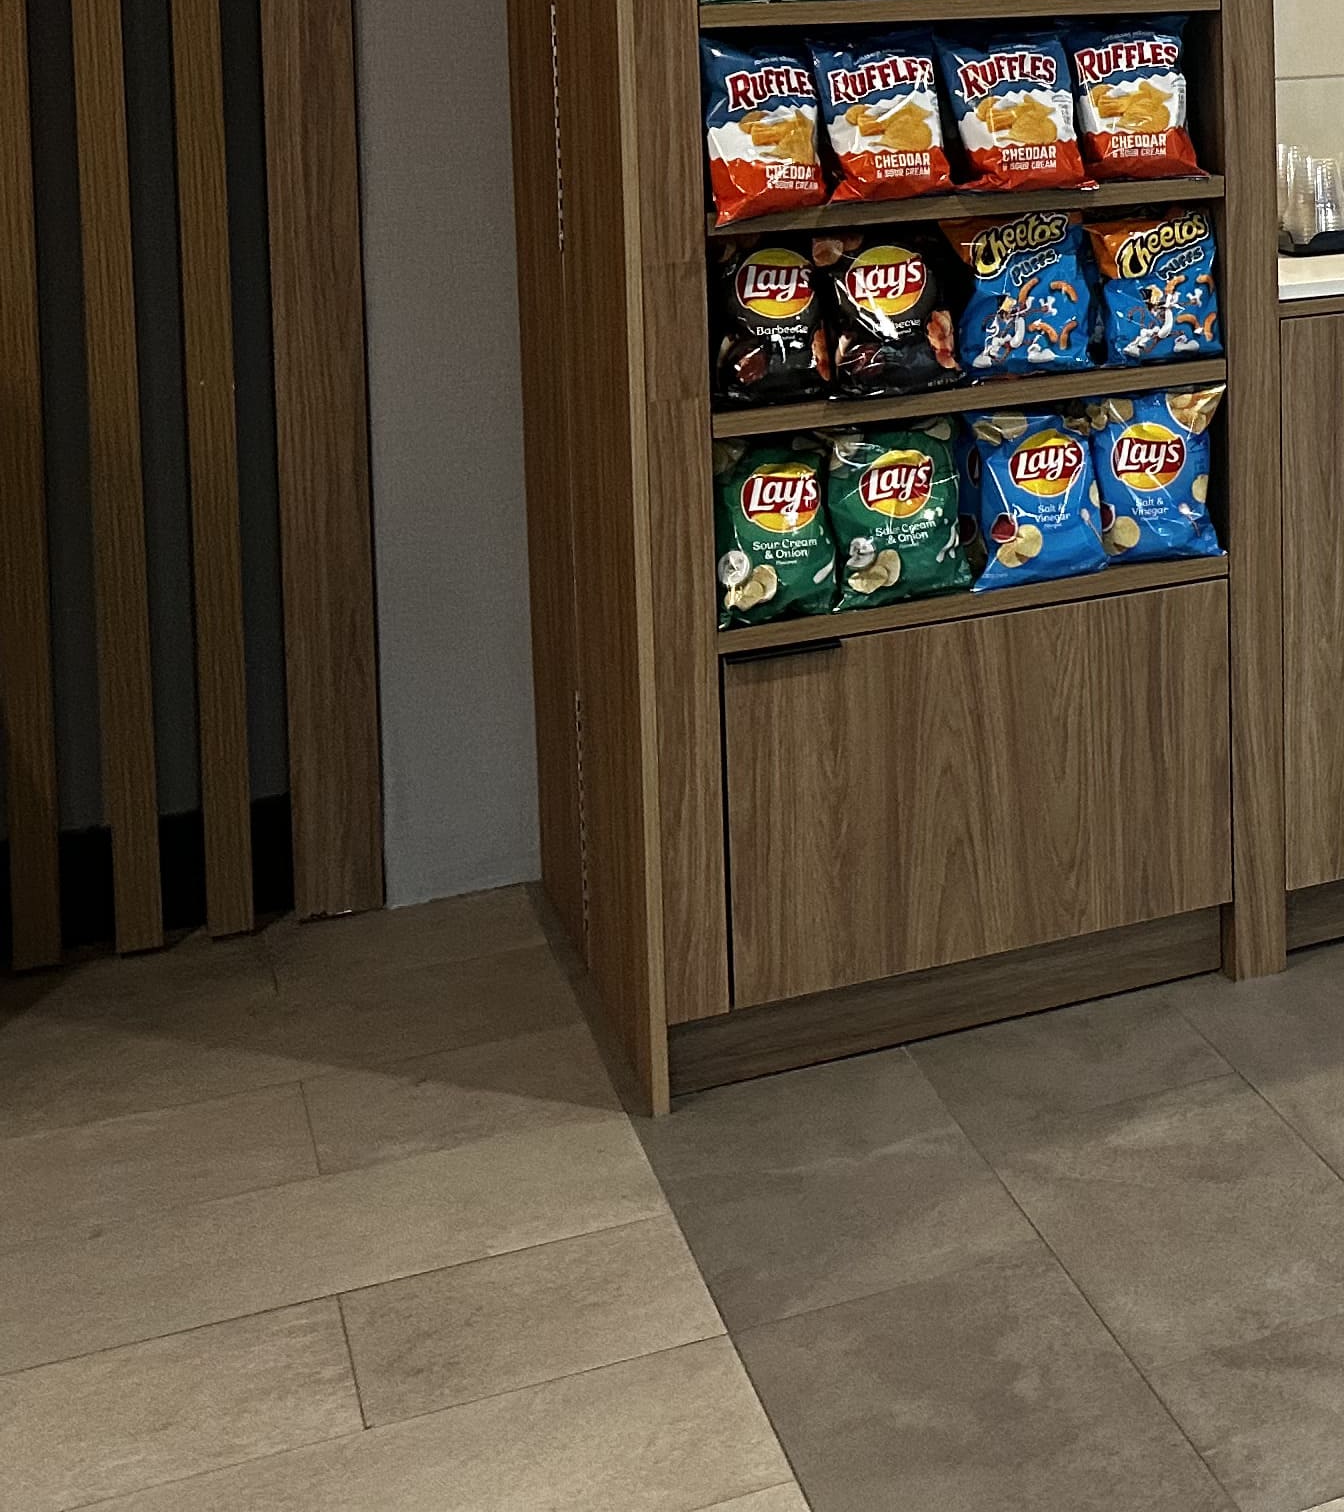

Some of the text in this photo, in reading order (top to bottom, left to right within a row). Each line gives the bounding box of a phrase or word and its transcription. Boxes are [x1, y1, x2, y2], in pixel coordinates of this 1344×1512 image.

[1074, 41, 1178, 85] RUFFLES
[828, 57, 934, 105] RUFFLES
[958, 52, 1057, 102] RUFFLES
[1111, 134, 1167, 150] CHEDDAR
[1002, 145, 1057, 162] CHEDDAR
[1140, 146, 1167, 156] CREAM
[874, 153, 931, 169] CHEDDAR
[905, 167, 931, 177] CREAM
[973, 214, 1067, 275] Cheetos
[1119, 214, 1208, 279] Cheetos
[744, 265, 812, 302] Lay's
[852, 258, 922, 299] Lay's
[1016, 445, 1078, 480] Lay's
[1117, 439, 1181, 473] Lay's
[868, 464, 931, 502] Lay's
[749, 475, 818, 514] Lay's
[1136, 497, 1164, 507] Salt &
[1038, 504, 1056, 513] Salt
[1131, 506, 1168, 518] Vinegar
[901, 520, 937, 533] Cream
[752, 538, 818, 551] Sour Cream
[887, 531, 929, 545] & Onion
[764, 548, 809, 560] & Onion
